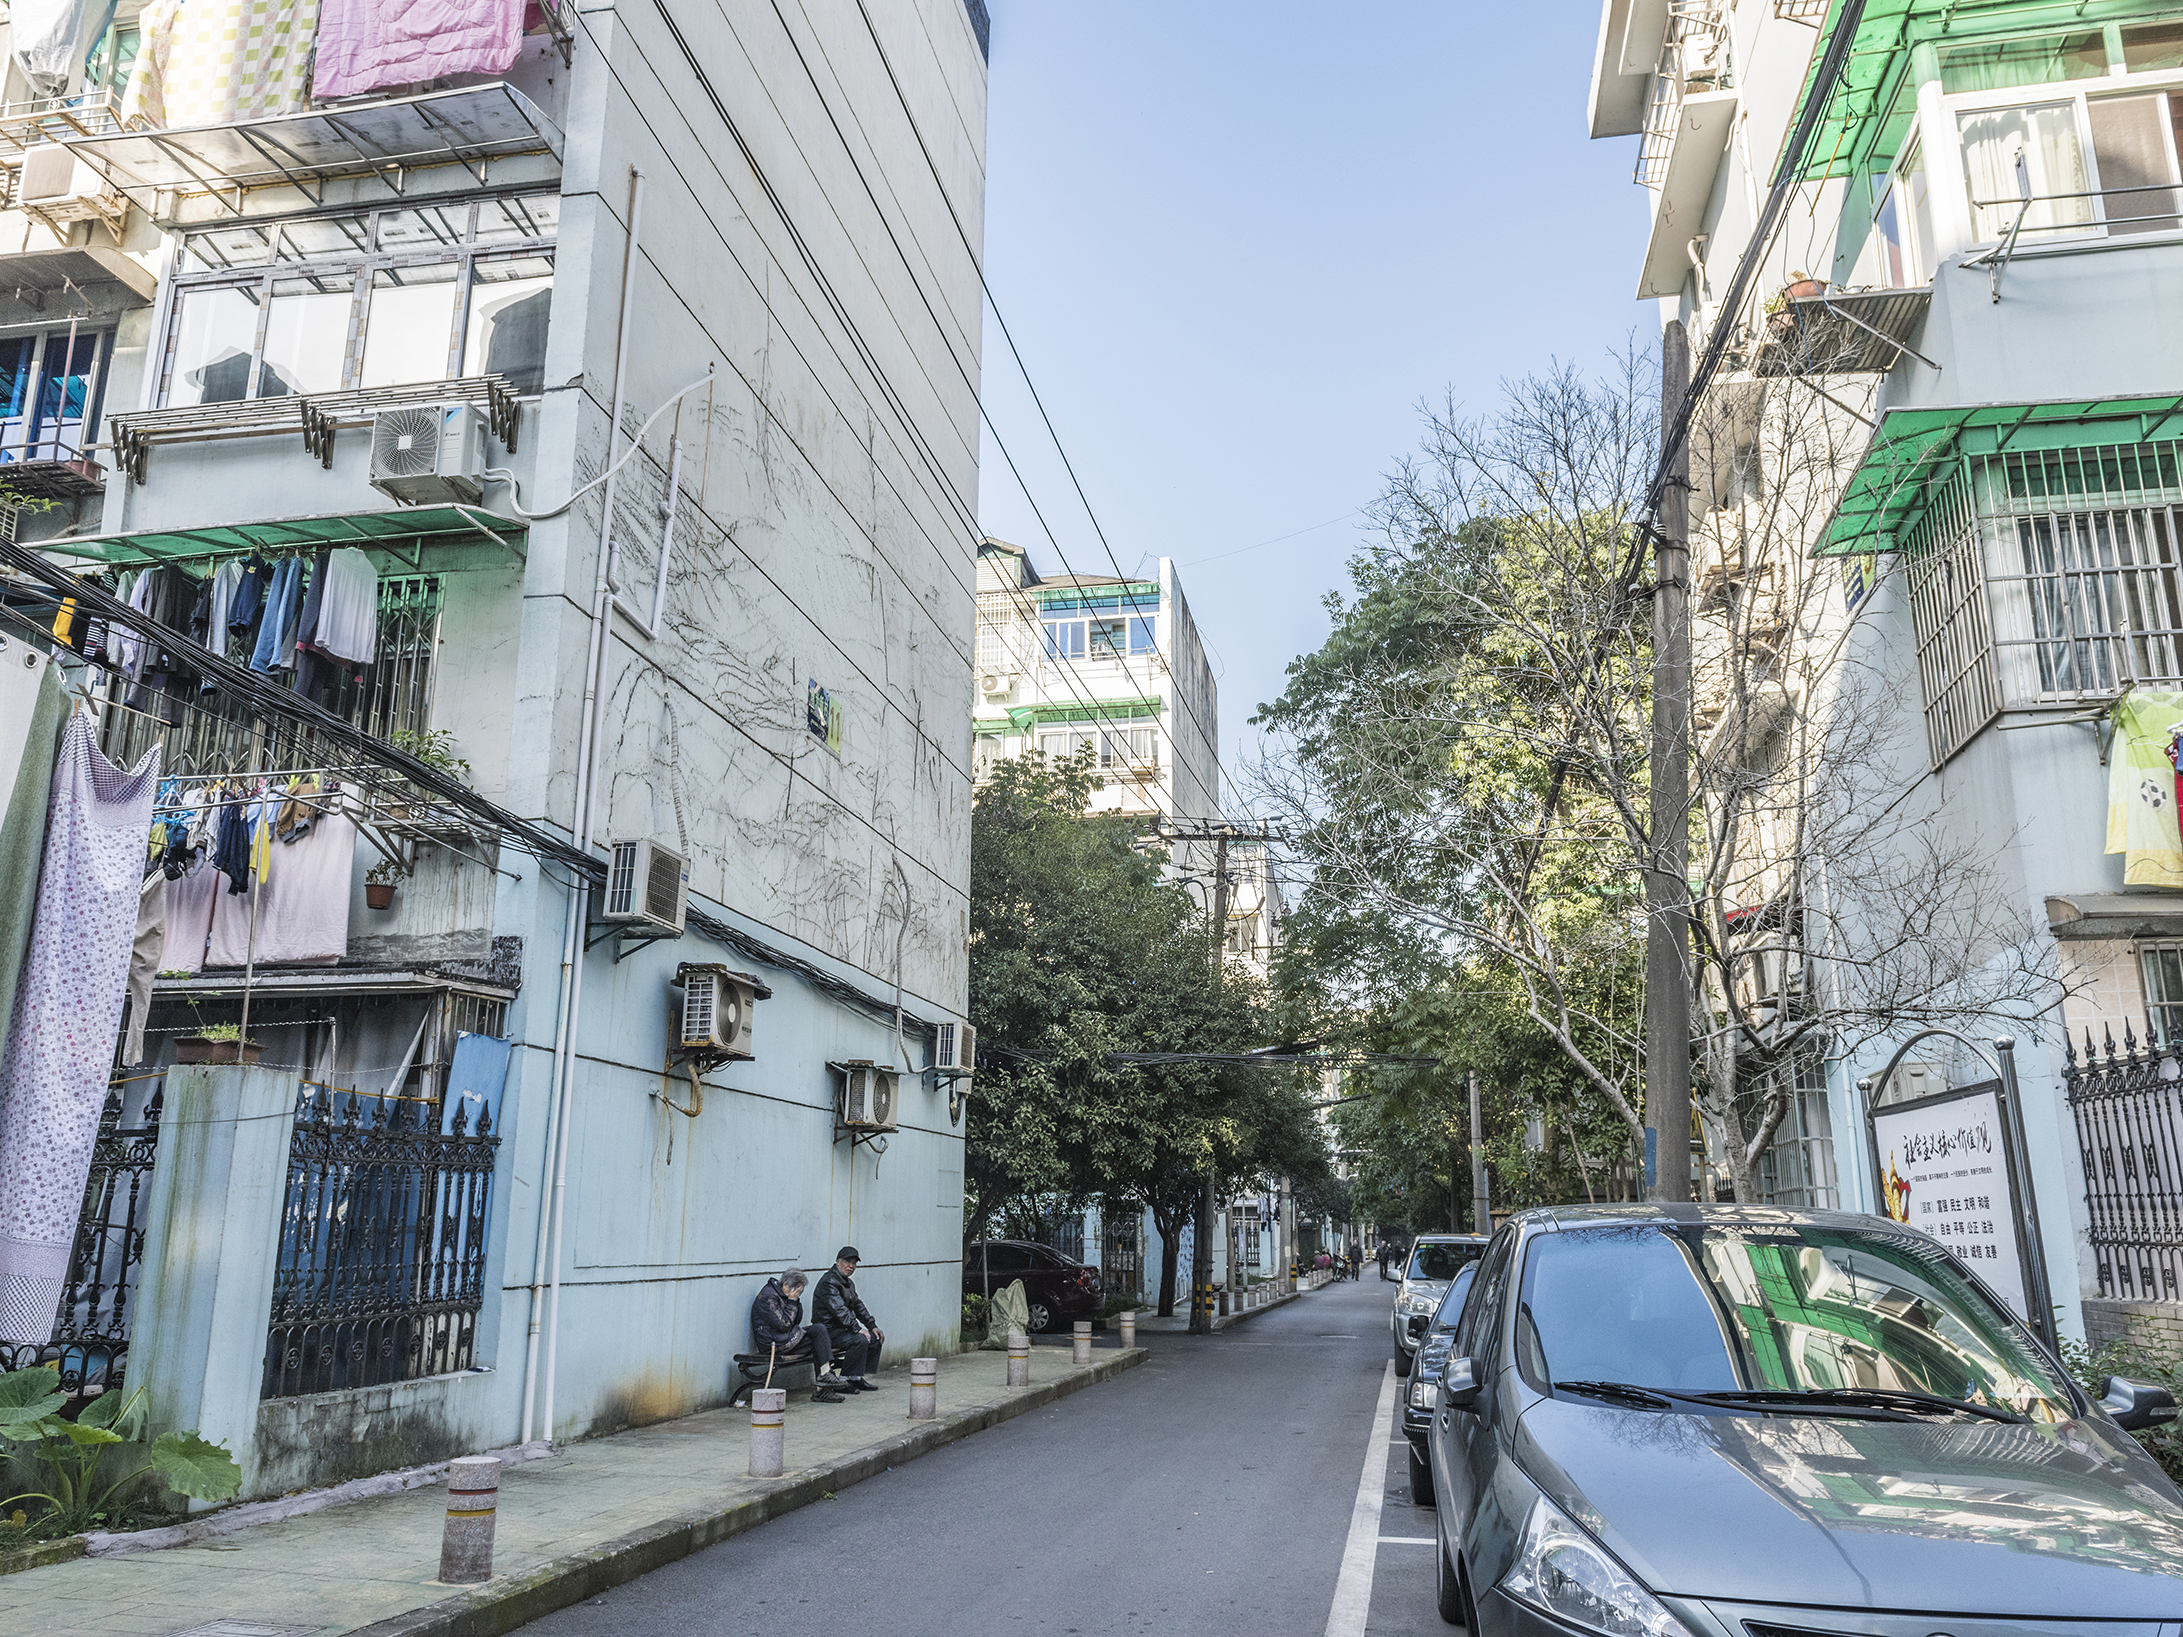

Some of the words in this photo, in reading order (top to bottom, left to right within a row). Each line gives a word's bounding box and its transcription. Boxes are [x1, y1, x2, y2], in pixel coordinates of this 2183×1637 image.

[830, 706, 840, 745] 11
[1950, 1198, 1962, 1211] 民主
[1940, 1222, 1951, 1236] 自由
[1953, 1221, 1965, 1235] 平等
[1967, 1221, 1979, 1234] 公正
